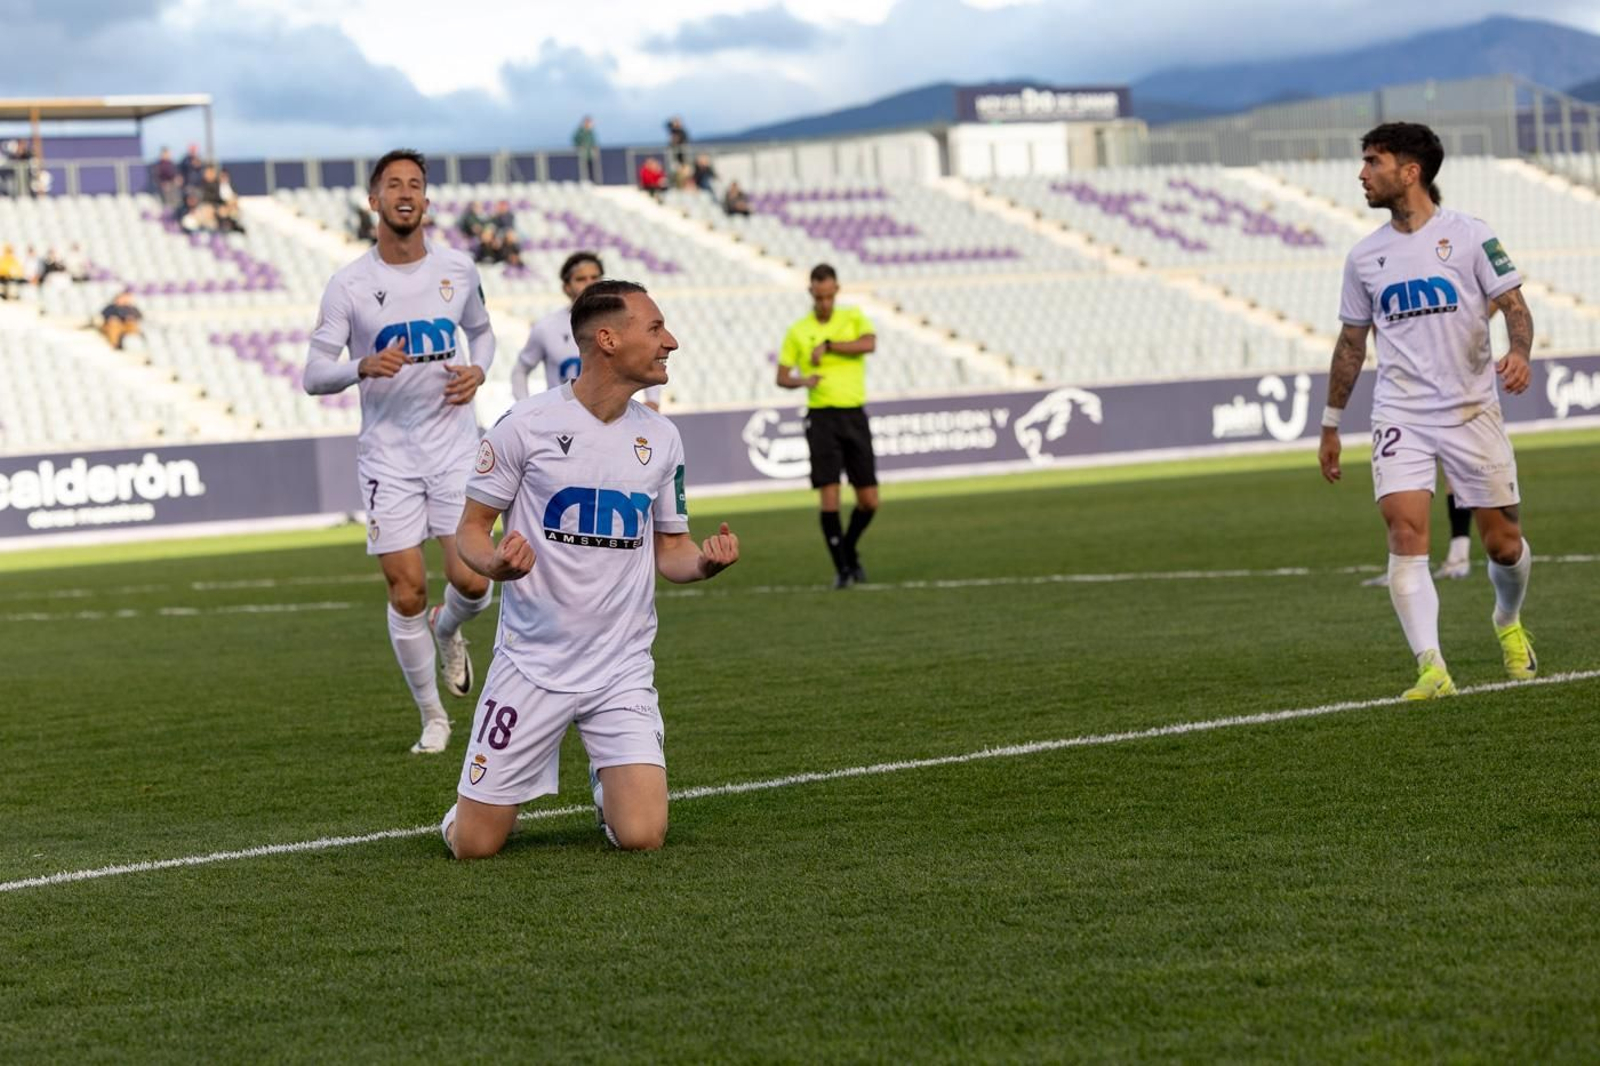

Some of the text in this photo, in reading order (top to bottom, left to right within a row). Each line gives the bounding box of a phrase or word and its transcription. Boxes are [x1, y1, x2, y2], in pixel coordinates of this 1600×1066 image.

[1372, 426, 1402, 462] 22
[367, 479, 379, 511] 7
[476, 699, 518, 750] 18
